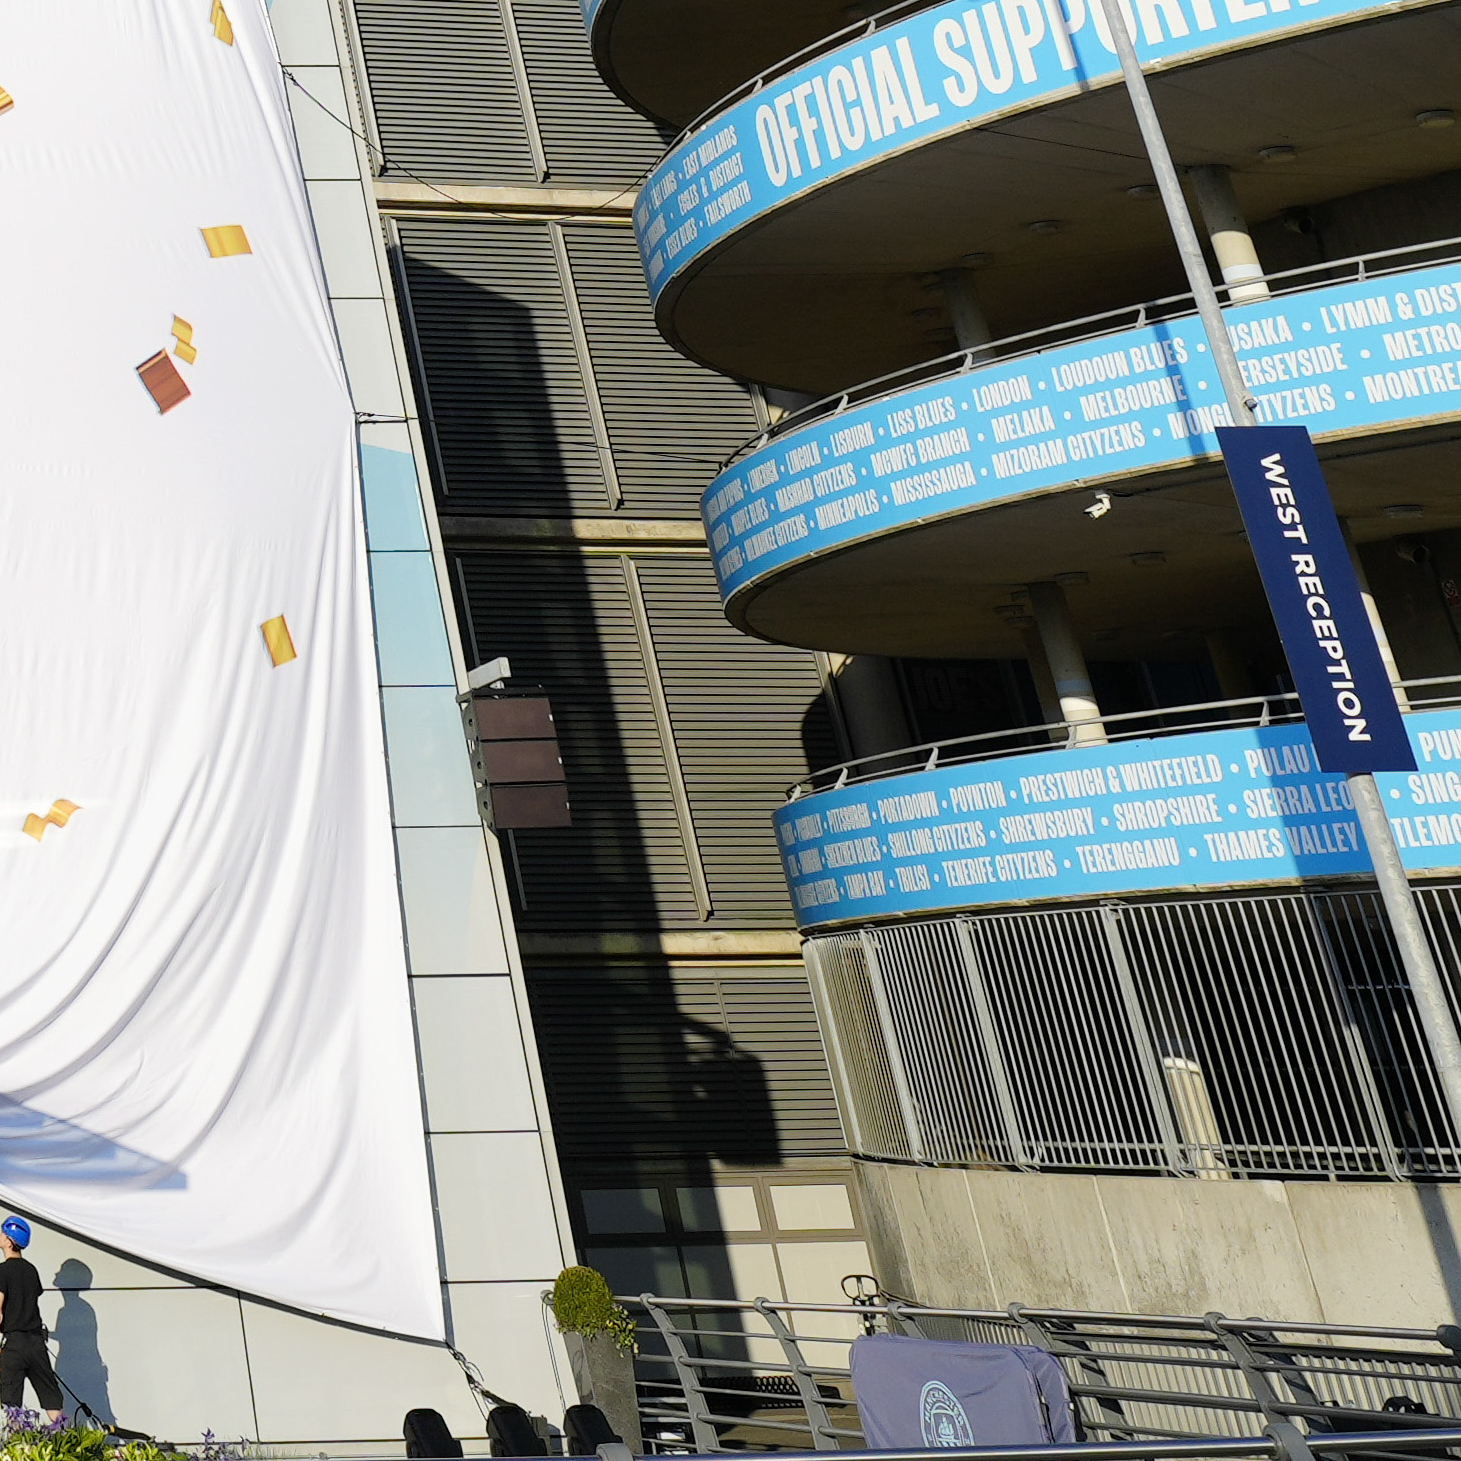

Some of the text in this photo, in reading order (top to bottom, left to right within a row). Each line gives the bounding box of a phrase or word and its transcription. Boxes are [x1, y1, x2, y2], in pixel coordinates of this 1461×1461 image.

[755, 23, 937, 187] OFFICIAL
[704, 180, 753, 227] FAILSWORTH
[709, 152, 744, 191] DISTRICT
[785, 441, 821, 475] LINCOLN
[830, 421, 876, 457] LISBURN
[887, 409, 916, 438] LISS
[913, 396, 956, 431] BLUES
[972, 374, 1033, 412] LONDON
[1051, 350, 1130, 392] LOUDOUN
[1129, 336, 1189, 374] BLUES
[1320, 296, 1393, 334] LYMM
[1395, 292, 1415, 320] &
[813, 321, 1461, 498] CITYZENS MCWFC BRANCH MELAKA MELBOURNE ERSEYSIDE METRO
[815, 488, 880, 530] MINNEAPOLIS
[890, 461, 977, 506] MISSISSAUGA
[991, 438, 1068, 479] MIZORAM
[1067, 420, 1146, 461] CITYZENS
[1260, 452, 1372, 742] WEST RECEPTION
[877, 790, 939, 824] PORTADOWN
[949, 780, 1007, 814] POYNTON
[1019, 767, 1107, 804] PRESTWICH
[1106, 765, 1122, 793] &
[1118, 753, 1223, 792] WHITEFIELD
[1244, 744, 1310, 778] PULAU
[888, 828, 934, 859] SHILLONG
[932, 820, 987, 853] CITYZENS
[999, 806, 1095, 845] SHREWSBURY
[1113, 793, 1223, 832] SHROPSHIRE
[1243, 784, 1317, 819] SIERRA
[1408, 771, 1461, 805] SING
[942, 821, 1359, 888] TENERIFE CITYZENS TERENGGANU THAMES VALLEY
